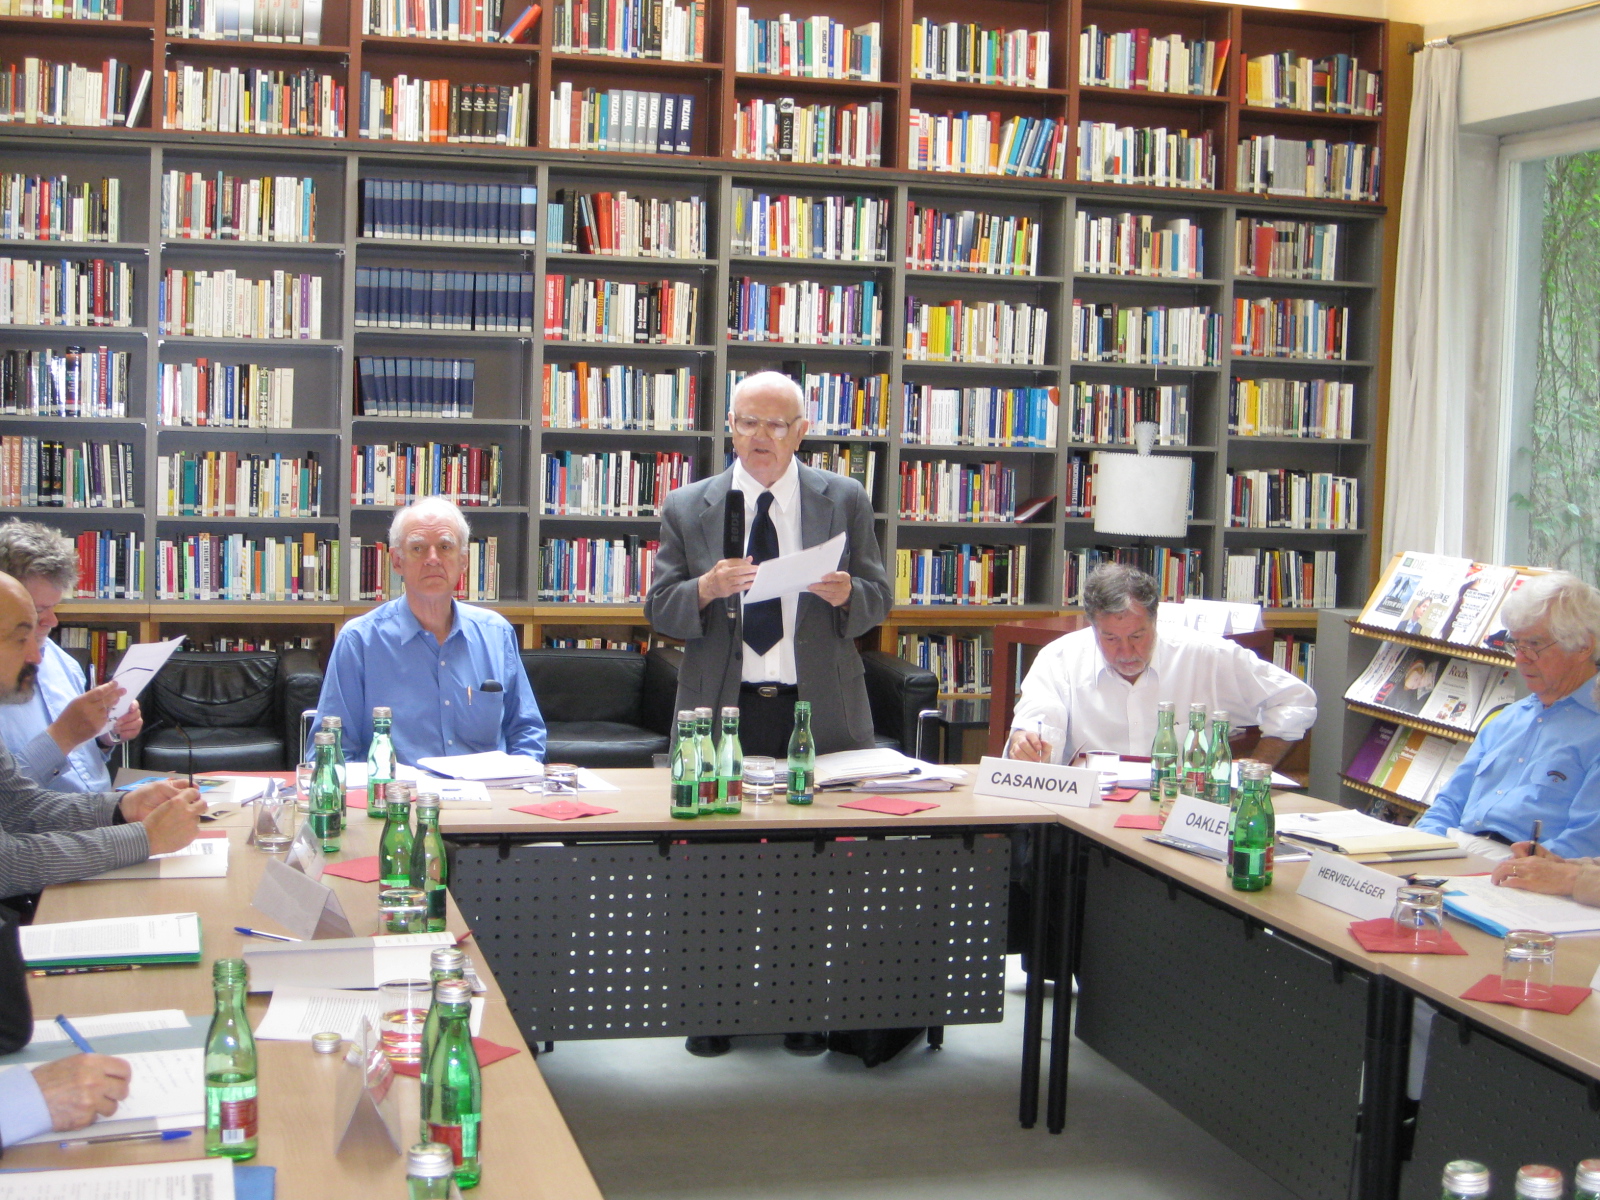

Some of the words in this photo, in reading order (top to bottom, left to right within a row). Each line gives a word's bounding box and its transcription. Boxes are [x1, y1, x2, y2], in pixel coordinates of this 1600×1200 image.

[624, 96, 633, 126] TROTZKI
[638, 97, 647, 128] TROTZKI
[649, 98, 658, 128] TROTZKI
[664, 98, 674, 129] TROTZKI
[680, 99, 691, 130] TROTZKI
[783, 119, 792, 149] sixtie
[1375, 683, 1395, 702] TLS
[991, 772, 1078, 795] CASANOVA
[1318, 866, 1386, 899] HERVIEU-LÉGER
